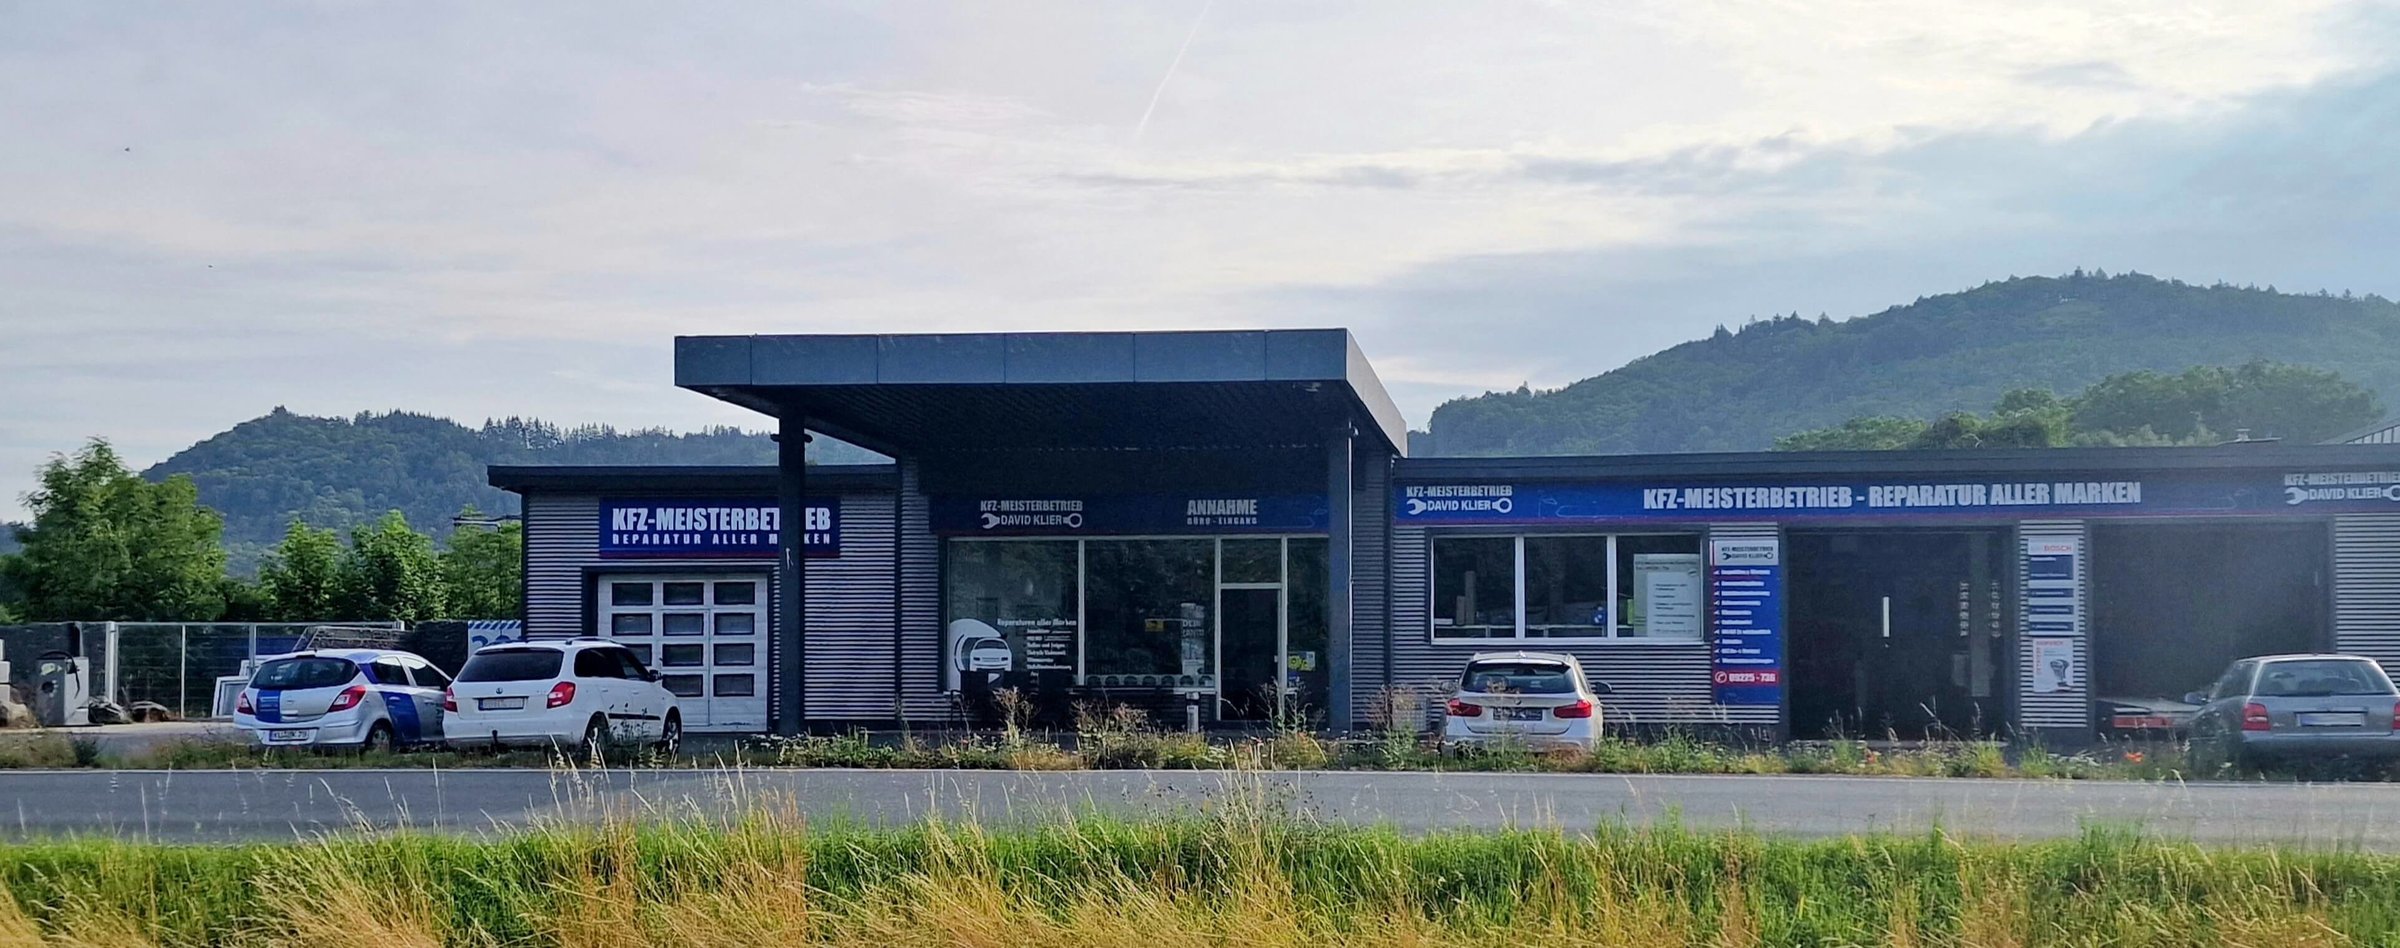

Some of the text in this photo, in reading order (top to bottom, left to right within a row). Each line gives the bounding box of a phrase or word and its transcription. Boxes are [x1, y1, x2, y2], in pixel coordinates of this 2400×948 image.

[2284, 472, 2400, 486] KFZ-MEISTERBETRIE
[1406, 485, 1512, 498] KFZ-MEISTERBETRIEB
[1643, 487, 1852, 510] KFZ-MEISTERBETRIEB
[1868, 485, 1987, 507] REPARATUR
[1990, 484, 2050, 506] ALLER
[2053, 483, 2141, 504] MARKEN
[2308, 487, 2382, 500] DAVID KLIER
[980, 500, 1083, 511] KFZ-MEISTERBETRIEB
[1187, 499, 1257, 515] ANNAHME
[1427, 500, 1492, 512] DAVID KLIER
[612, 507, 830, 531] KFZ-MEISTERBETEB
[1001, 514, 1062, 525] DAVID KLIER
[612, 533, 831, 545] REPARATUR ALLER MKEN
